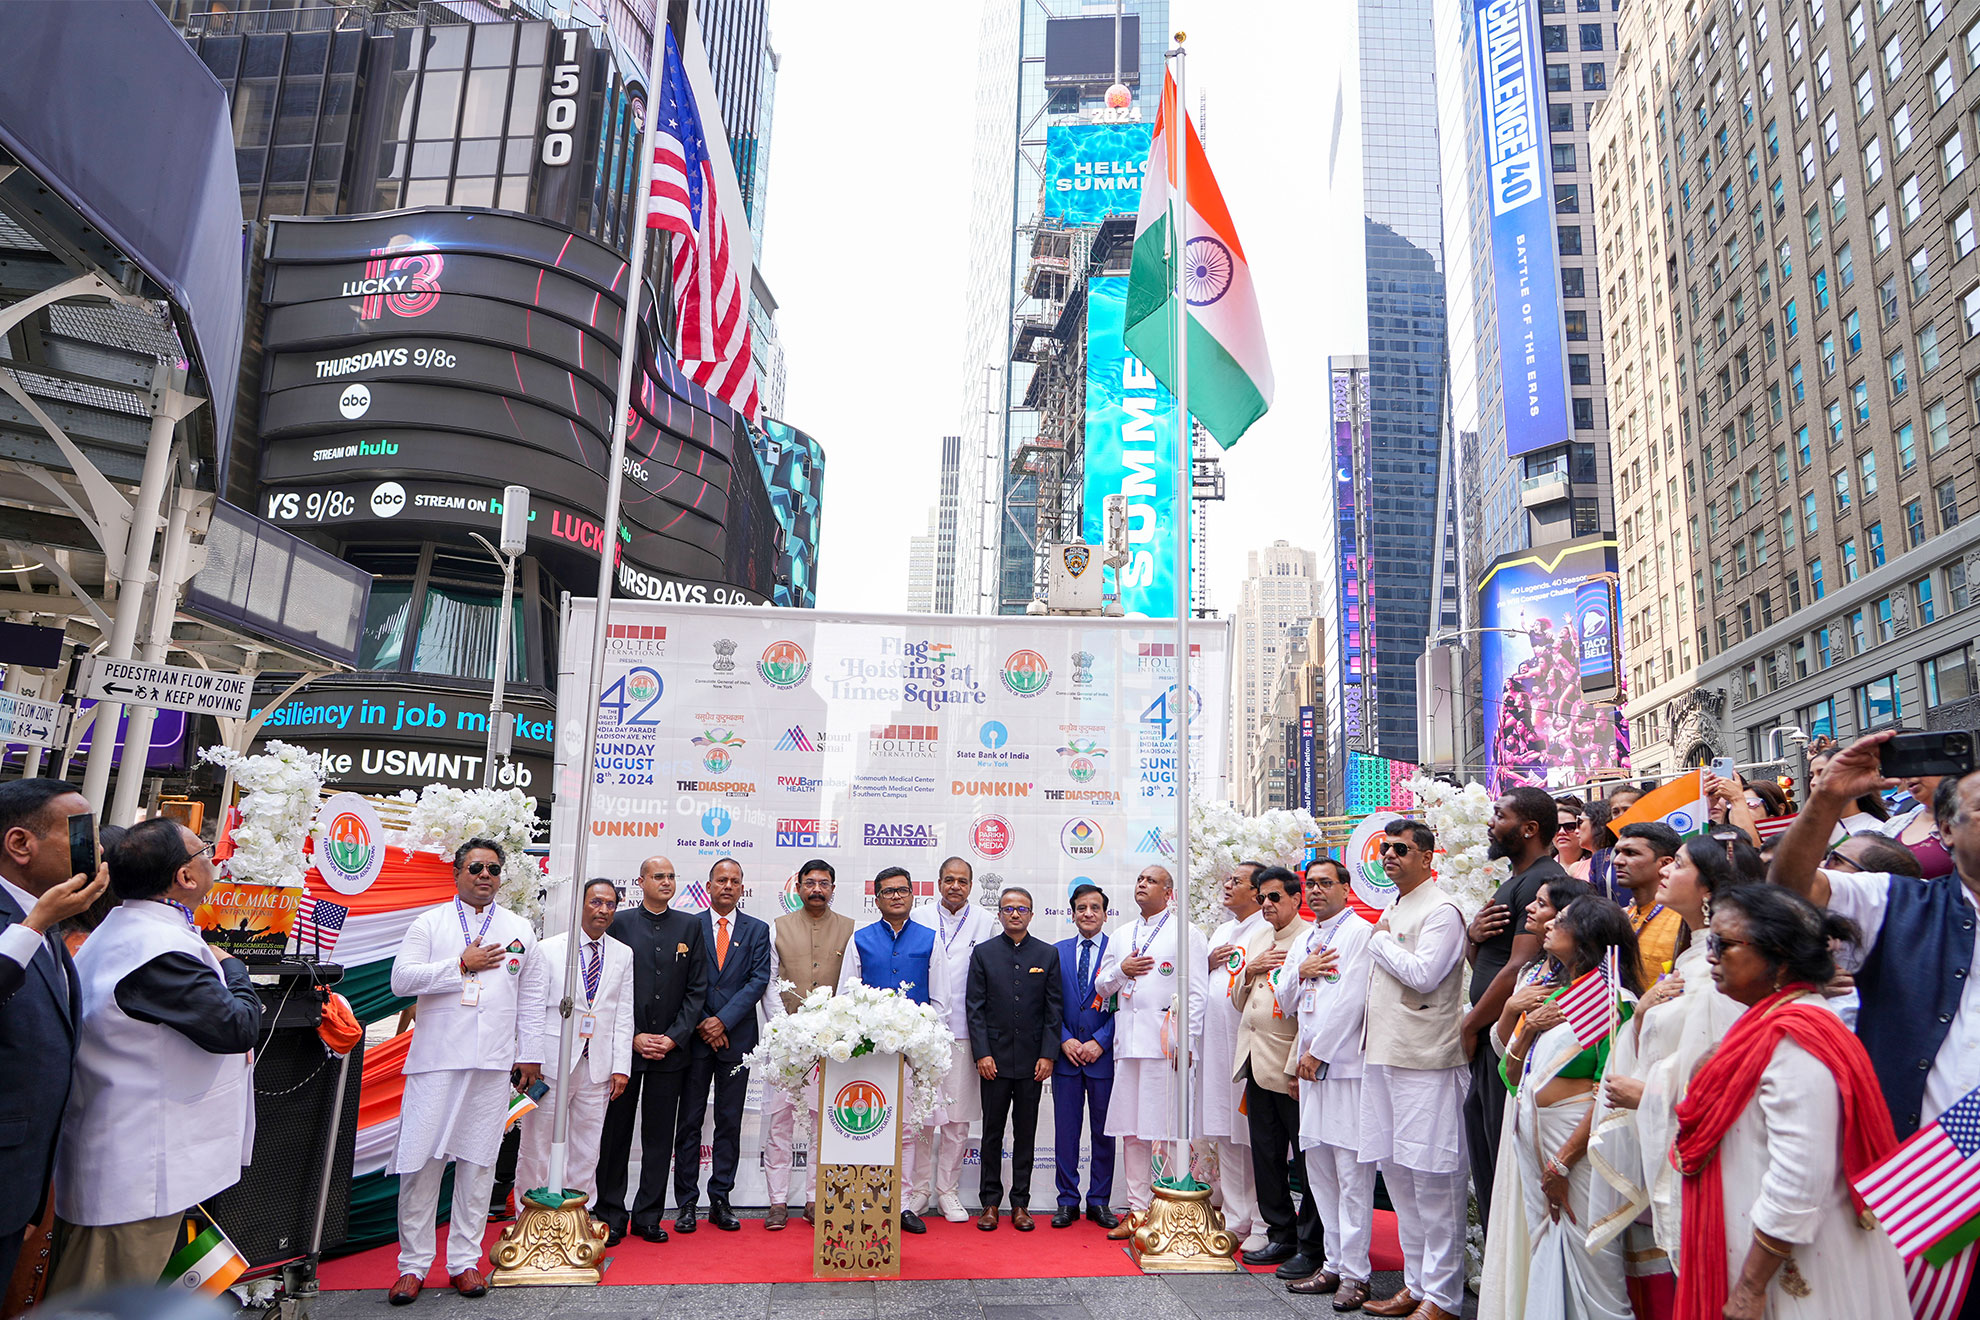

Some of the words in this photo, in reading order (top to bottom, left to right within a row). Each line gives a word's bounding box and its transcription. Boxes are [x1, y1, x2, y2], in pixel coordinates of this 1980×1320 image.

[542, 31, 580, 166] 1500
[1091, 107, 1142, 124] 2024
[1056, 176, 1144, 191] SUMM
[1501, 161, 1532, 204] 40
[1516, 233, 1530, 298] BATTLE
[342, 275, 408, 296] LUCKY
[1522, 303, 1532, 325] OF
[1524, 331, 1535, 365] THE
[315, 347, 409, 378] THURSDAYS
[413, 348, 457, 369] 9/8c
[341, 394, 369, 407] abc
[1527, 370, 1540, 417] ERAS
[312, 447, 344, 461] STREAM
[345, 445, 358, 457] ON
[359, 439, 399, 455] hulu
[622, 456, 649, 482] 9/8c
[1121, 346, 1158, 588] SUMME
[305, 490, 355, 521] 9/8c
[372, 491, 403, 506] abc
[414, 494, 465, 510] STREAM
[467, 498, 487, 512] ON
[489, 498, 536, 522] hu
[551, 510, 606, 555] LUCK
[619, 560, 707, 606] URSDAYS
[1510, 587, 1521, 595] 40
[1551, 579, 1562, 587] 40
[1550, 587, 1578, 597] Challen
[605, 639, 666, 652] OLTEC
[1582, 637, 1608, 650] TACO
[607, 649, 664, 657] TERNATIONAL
[1585, 647, 1609, 659] BELL
[104, 662, 177, 687] PEDESTRIAN
[181, 673, 214, 690] FLOW
[215, 679, 246, 695] ZONE
[950, 664, 979, 690] at
[164, 690, 195, 706] KEEP
[198, 694, 243, 712] MOVING
[599, 666, 664, 726] 42
[903, 682, 986, 712] Square
[17, 702, 36, 719] FLOW
[35, 706, 54, 722] ZONE
[250, 701, 354, 729] resiliency
[359, 700, 386, 724] in
[392, 700, 447, 731] job
[457, 710, 555, 742] mket
[869, 740, 938, 753] HOLTEC
[956, 751, 977, 759] State
[978, 751, 998, 760] Bank
[999, 751, 1009, 760] of
[1009, 752, 1030, 760] India
[1140, 757, 1200, 770] SUNY
[321, 748, 352, 774] ke
[361, 749, 483, 782] USMNT
[491, 758, 532, 788] job
[618, 773, 654, 785] 2024
[914, 776, 935, 784] Center
[914, 785, 935, 793] Center
[951, 780, 1034, 797] DUNKIN'
[589, 820, 665, 838] UNKIN'
[777, 819, 838, 832] TIMES
[864, 823, 938, 838] BANSAL
[676, 838, 698, 848] State
[699, 839, 720, 848] Bank
[721, 839, 731, 848] of
[732, 840, 754, 848] India
[777, 833, 838, 847] NOW
[864, 838, 938, 846] FOUNDATION
[715, 849, 732, 857] York
[201, 891, 245, 908] MAGIC
[245, 893, 279, 909] MIKE
[279, 895, 301, 912] DJS
[220, 907, 274, 917] INTERNATIONAL
[1044, 907, 1064, 916] State
